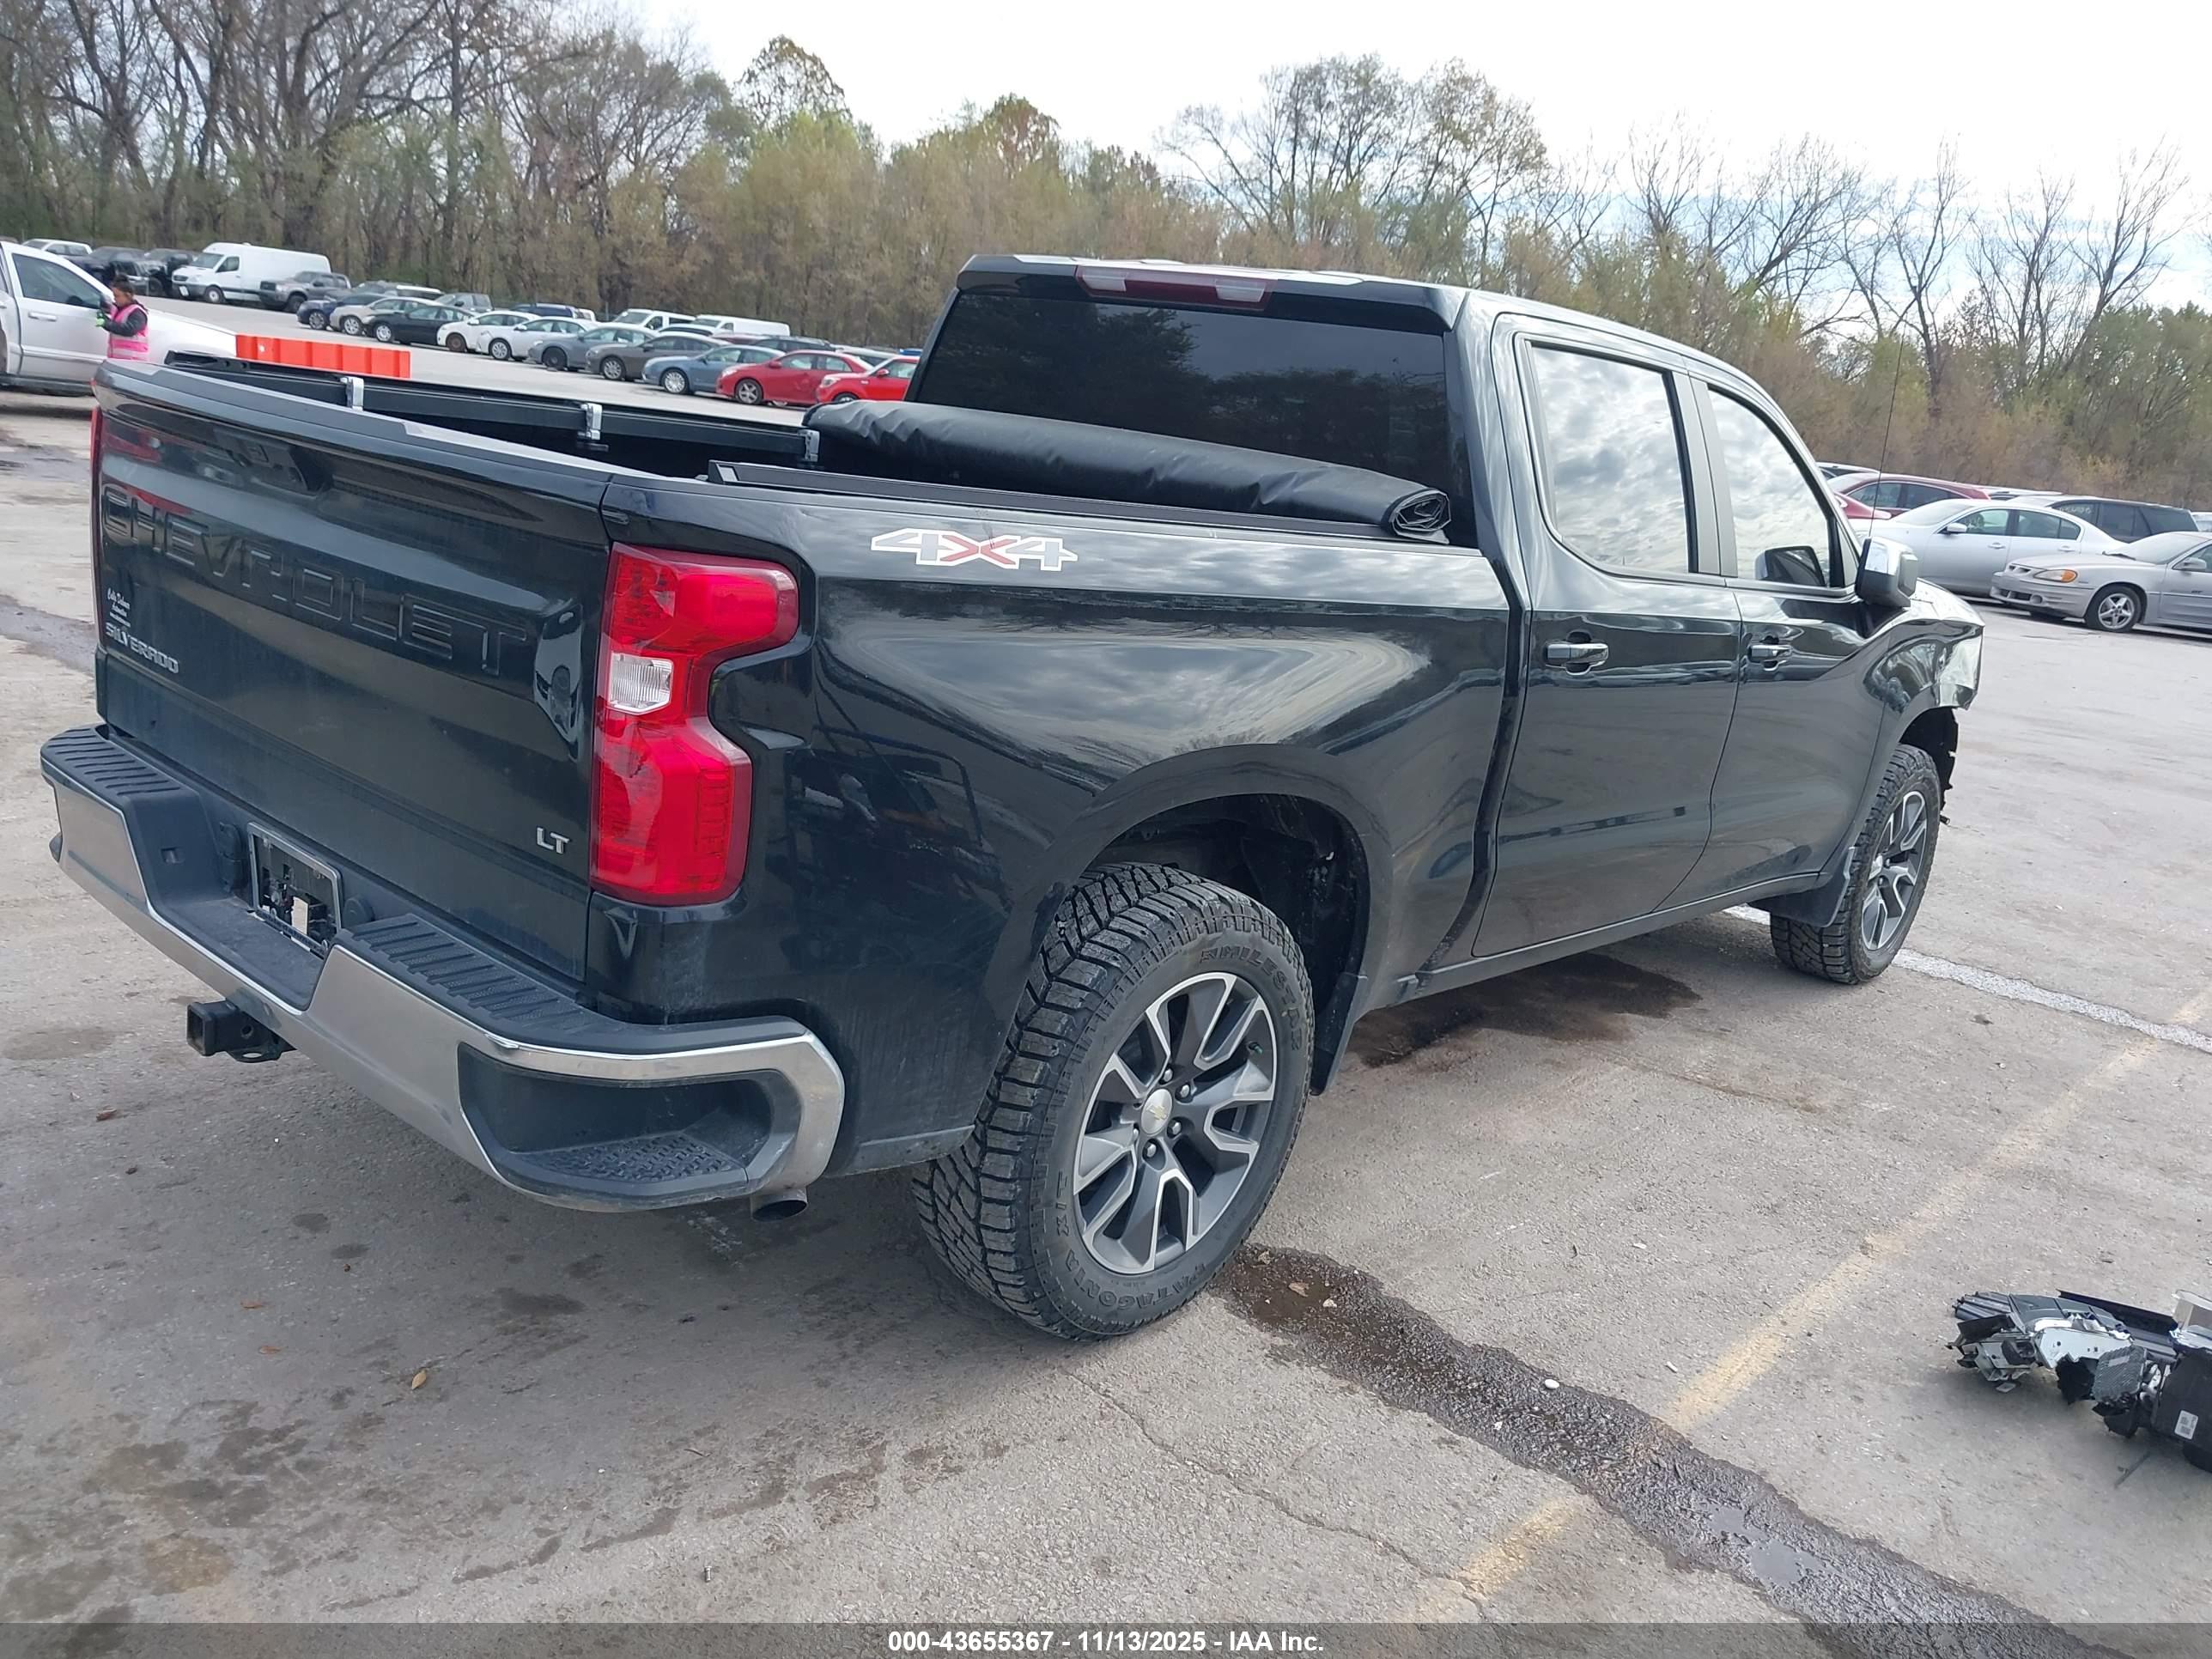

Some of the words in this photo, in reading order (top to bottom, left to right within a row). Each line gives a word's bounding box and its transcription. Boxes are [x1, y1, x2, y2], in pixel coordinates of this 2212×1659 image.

[102, 483, 529, 676] CHEVROLET
[106, 622, 179, 674] SILVERADO
[537, 827, 569, 854] LT
